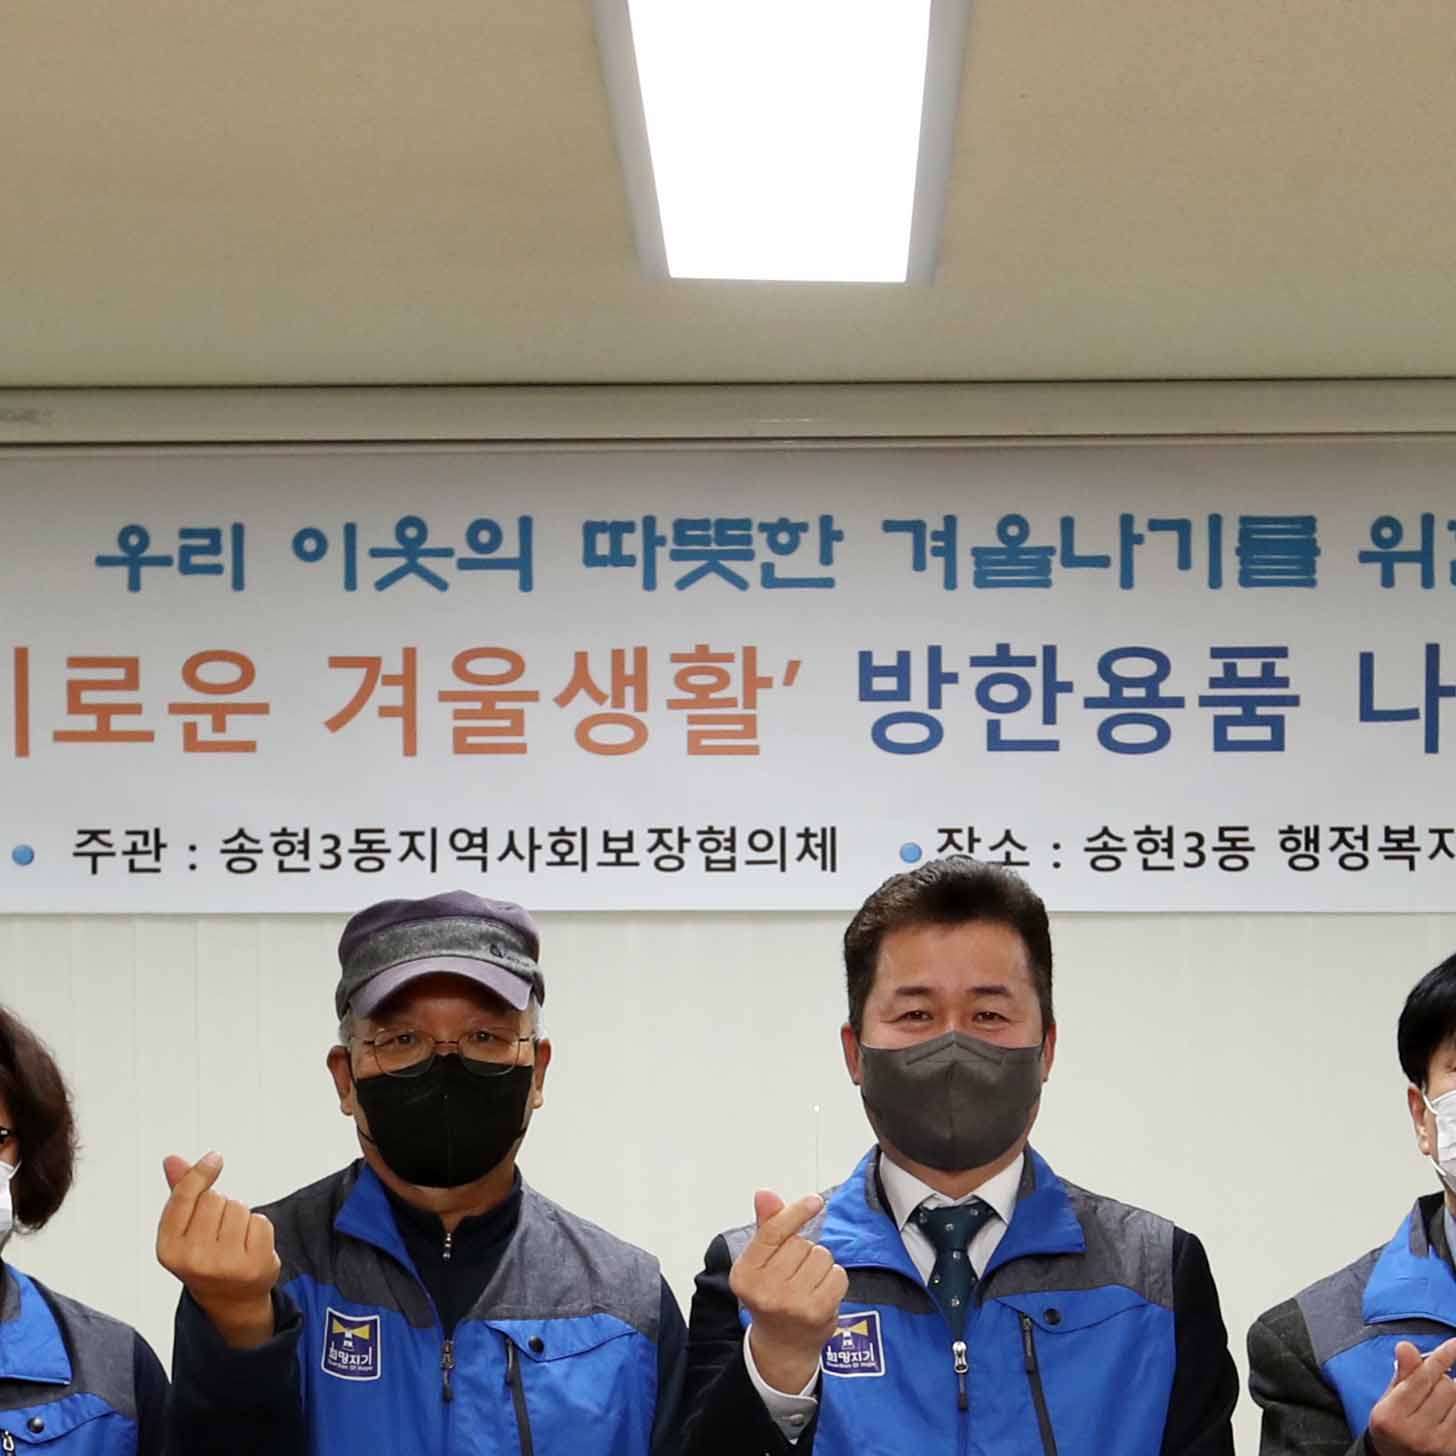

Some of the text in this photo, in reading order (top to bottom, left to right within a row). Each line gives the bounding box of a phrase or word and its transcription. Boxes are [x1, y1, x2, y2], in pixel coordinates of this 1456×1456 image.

[95, 522, 247, 593] 우리
[292, 516, 534, 593] 이웃의
[582, 514, 844, 591] 따뜻한
[881, 512, 1321, 592] 겨울나기를
[324, 644, 803, 758] 겨울생활'
[857, 644, 1302, 754] 방한용품
[71, 829, 168, 876] 주관
[218, 825, 839, 876] 송현3동지역사회보장협의체
[937, 827, 1033, 871] 장소
[1083, 825, 1255, 872] 송현3동
